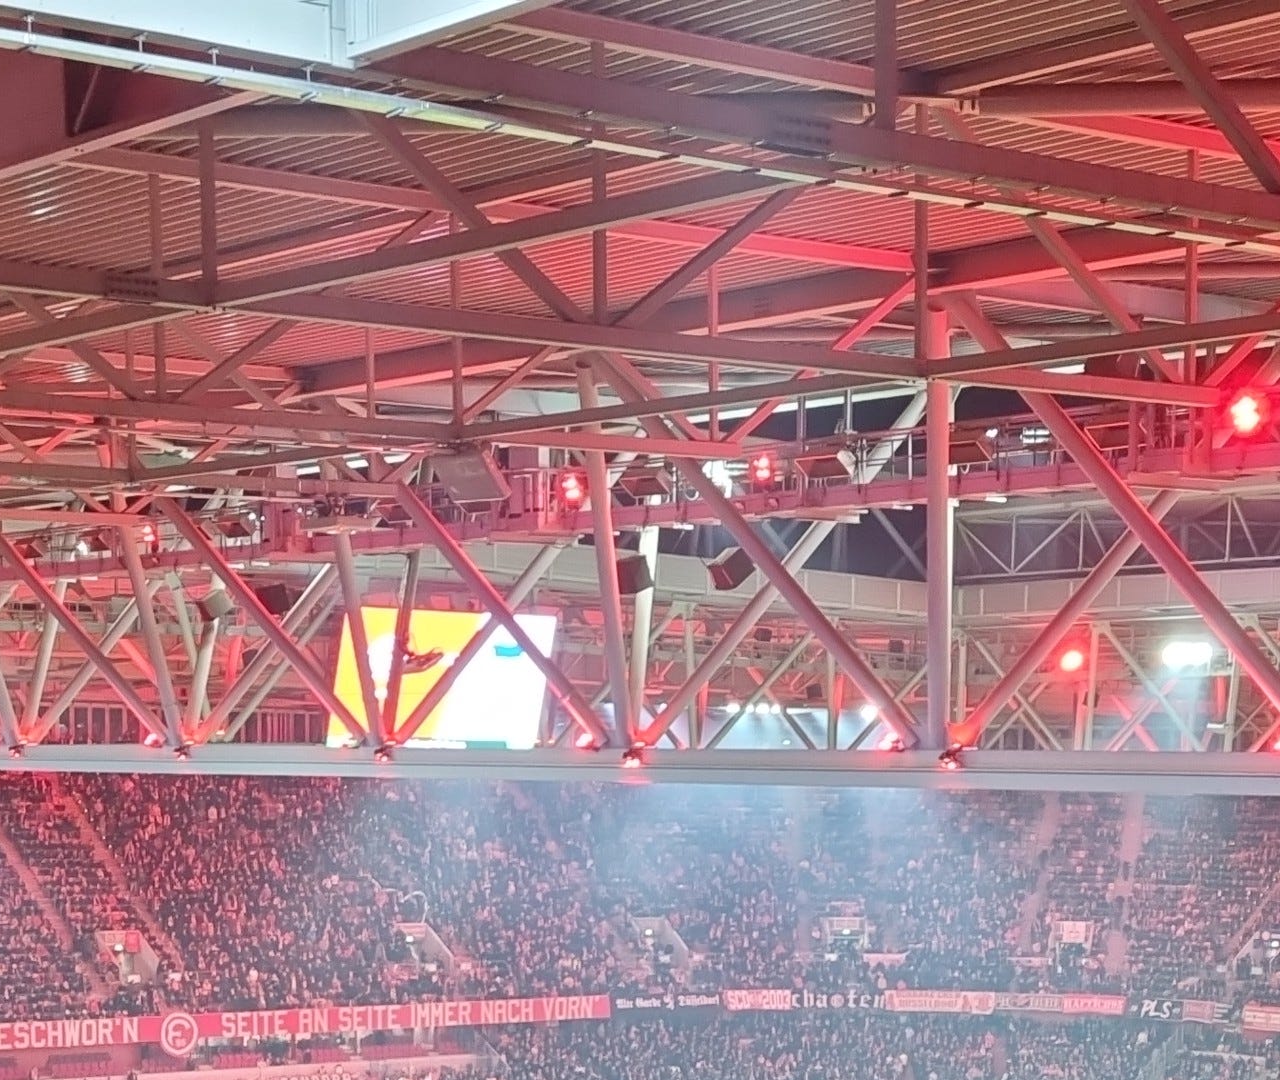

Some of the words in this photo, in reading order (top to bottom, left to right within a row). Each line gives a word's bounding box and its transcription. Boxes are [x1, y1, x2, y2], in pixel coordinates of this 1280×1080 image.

[221, 1009, 289, 1039] SEITE
[299, 1007, 328, 1034] AN
[339, 1004, 401, 1032] SEITE
[411, 1000, 472, 1028] IMMER
[480, 998, 534, 1025] NACH
